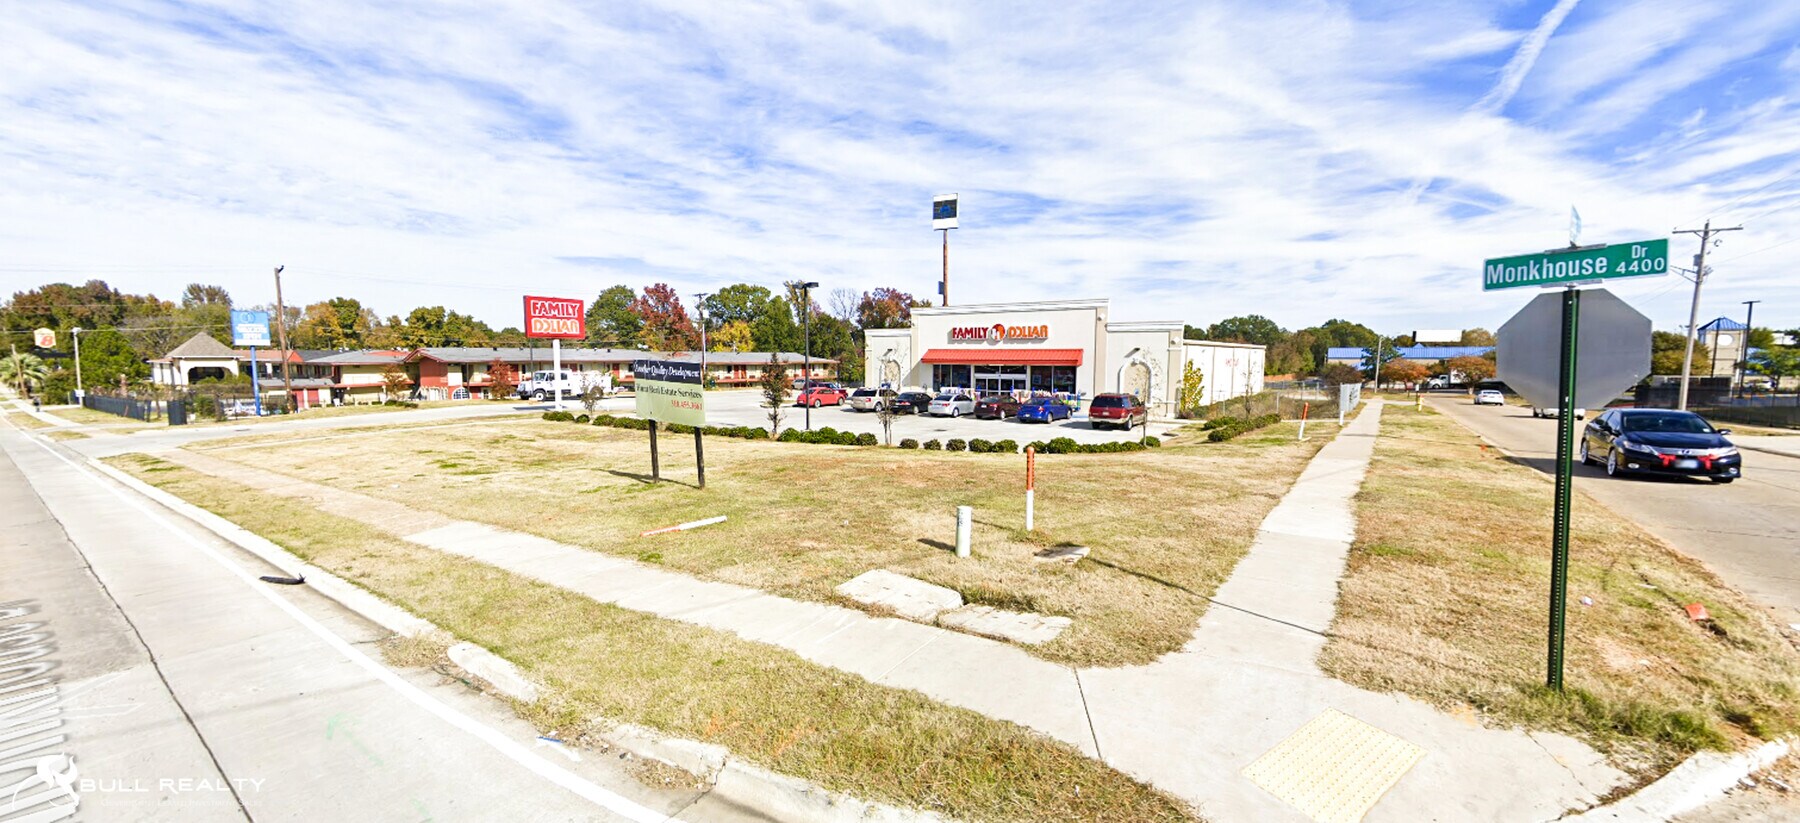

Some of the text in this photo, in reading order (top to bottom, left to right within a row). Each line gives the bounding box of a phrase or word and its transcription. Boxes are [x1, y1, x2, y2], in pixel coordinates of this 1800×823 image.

[1631, 245, 1649, 259] Dr
[1486, 256, 1665, 284] Monkhouse 4400
[531, 300, 580, 318] FAMILY
[531, 317, 580, 335] DOLLAR
[952, 325, 1049, 339] FAMILY DOLLAR
[661, 386, 677, 397] Estate
[678, 387, 703, 399] Services
